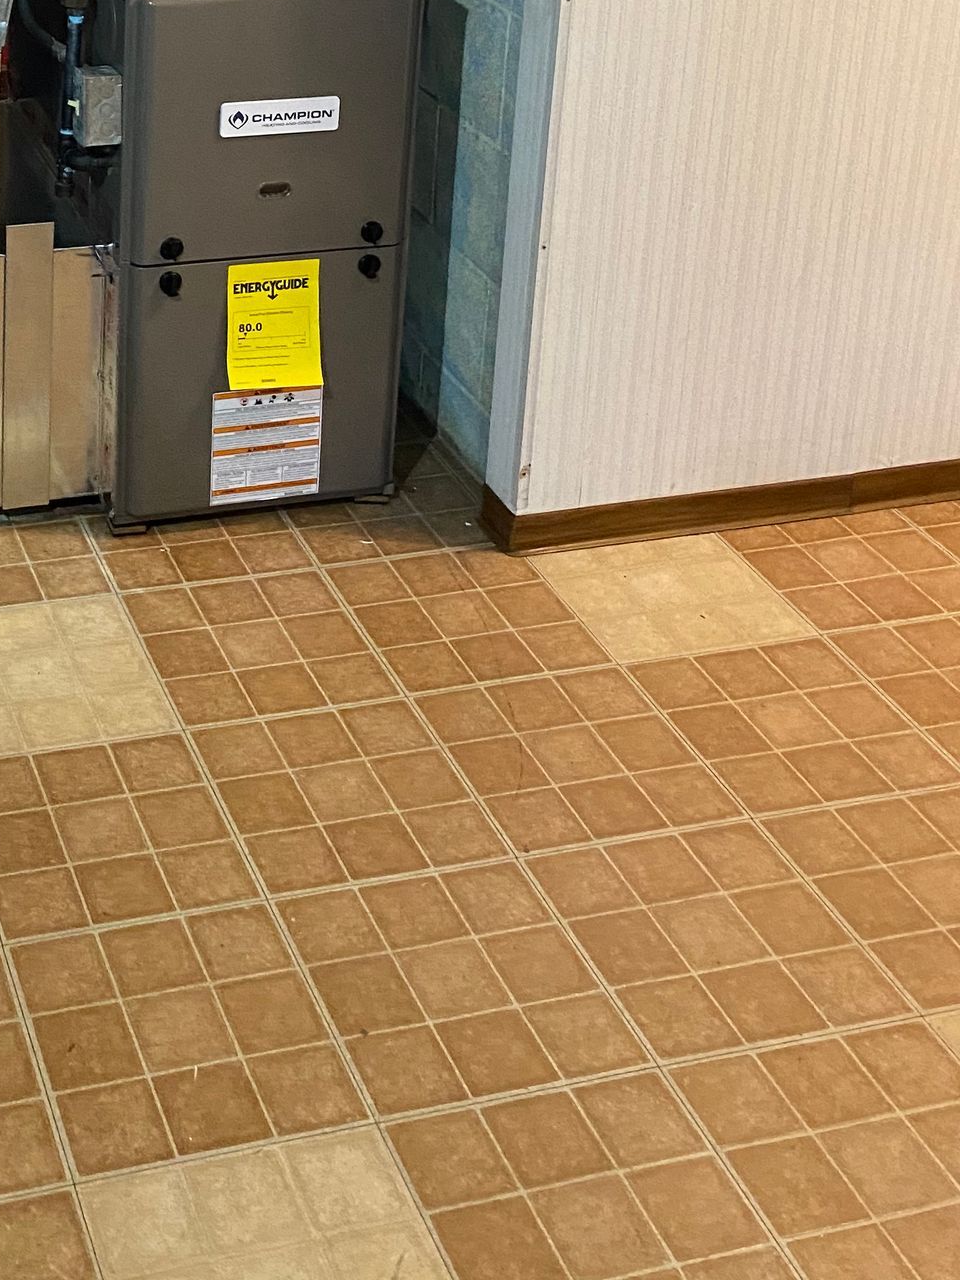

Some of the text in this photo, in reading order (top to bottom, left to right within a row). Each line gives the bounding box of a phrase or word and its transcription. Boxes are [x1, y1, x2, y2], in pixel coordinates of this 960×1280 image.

[252, 109, 333, 123] CHAMPION
[233, 278, 309, 299] ENERGYGUIDE
[238, 322, 263, 332] 80.0
